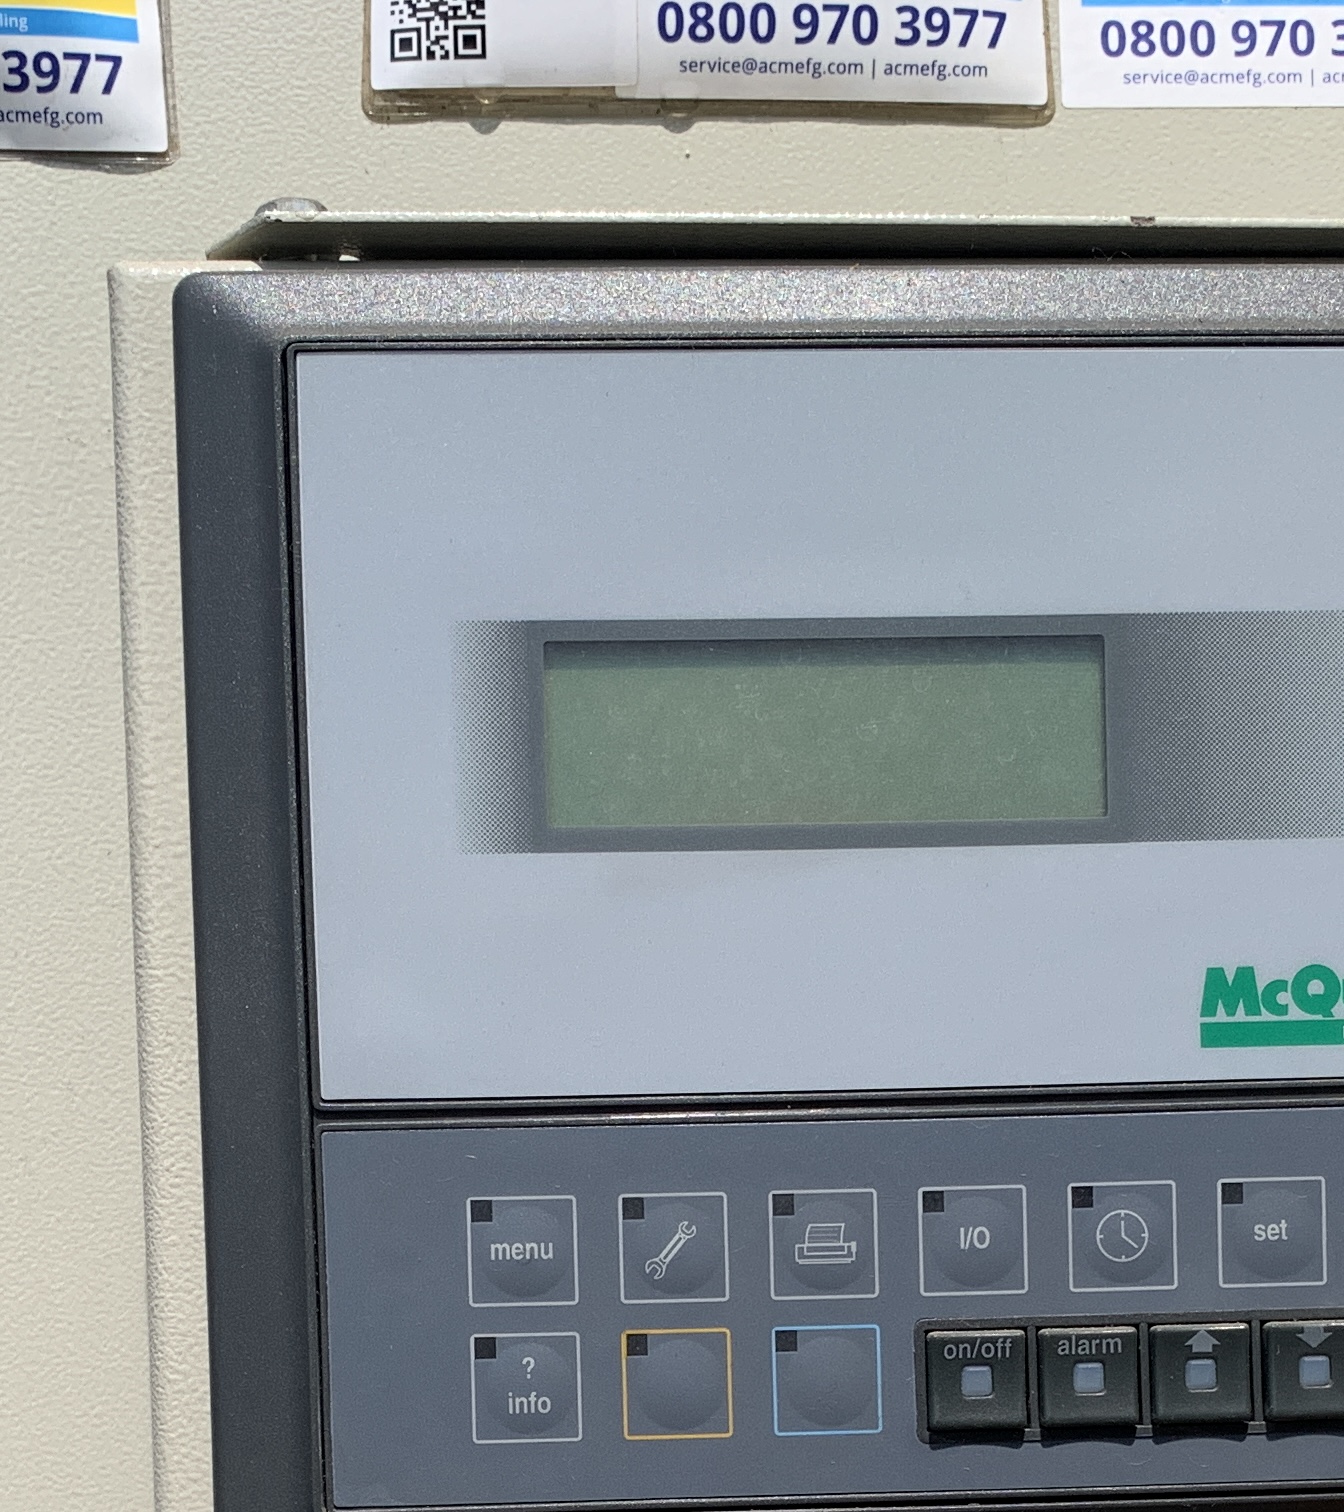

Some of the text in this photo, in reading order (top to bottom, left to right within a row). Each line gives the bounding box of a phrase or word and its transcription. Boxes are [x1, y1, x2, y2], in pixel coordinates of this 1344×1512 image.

[657, 2, 1007, 49] 0800 970 3977
[1100, 20, 1216, 58] 0800
[1231, 19, 1316, 58] 970
[1, 51, 123, 95] 3977
[679, 55, 864, 77] service@acmefg.com
[883, 59, 989, 80] acmefg.com
[1122, 69, 1302, 87] service@acmefg.com
[959, 1226, 991, 1252] I/O
[1253, 1219, 1289, 1242] set
[490, 1239, 554, 1260] menu
[943, 1338, 1013, 1361] on/off
[1057, 1333, 1123, 1357] alarm
[507, 1391, 552, 1414] info
